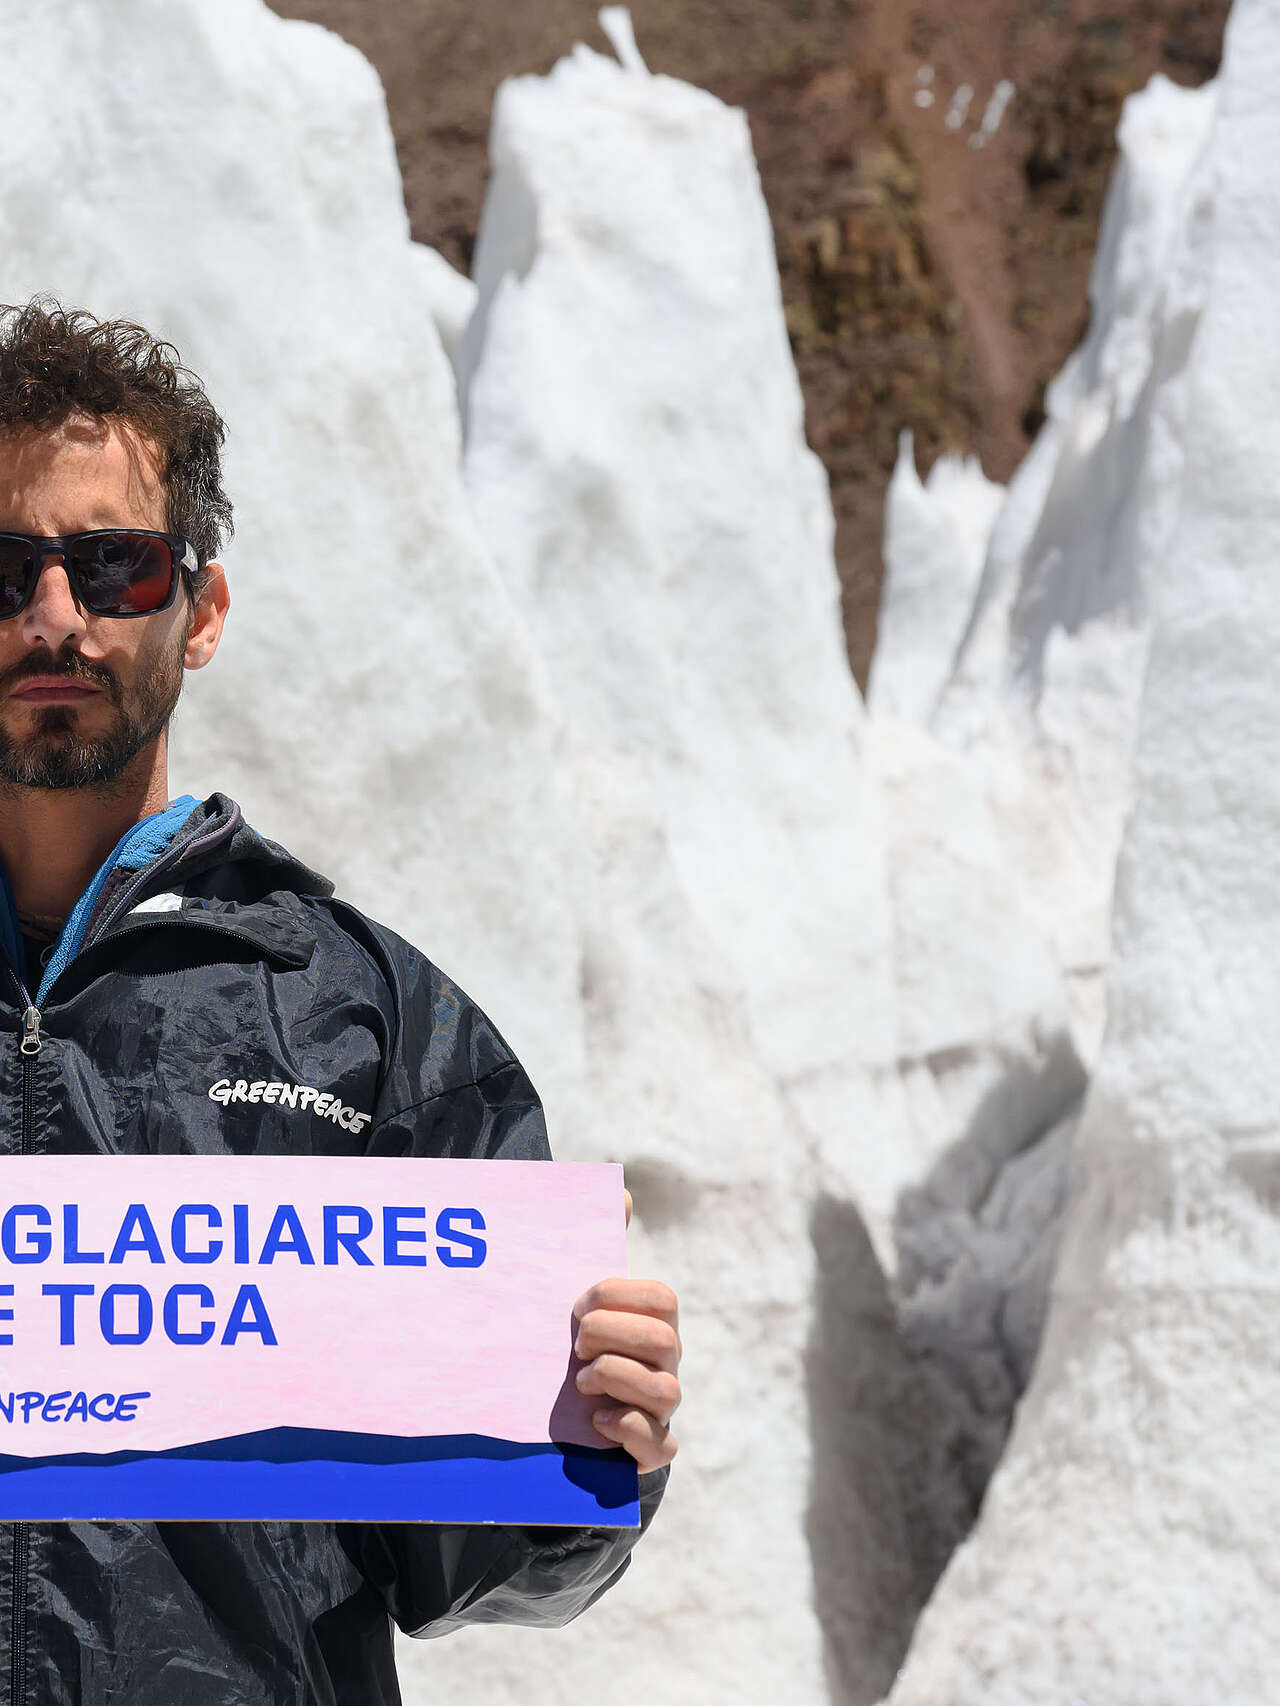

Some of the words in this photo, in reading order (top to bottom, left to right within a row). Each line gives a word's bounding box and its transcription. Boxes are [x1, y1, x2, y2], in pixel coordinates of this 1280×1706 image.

[209, 1079, 371, 1133] GREENPEACE
[2, 1204, 486, 1268] GLACIARES
[42, 1284, 278, 1345] TOCA
